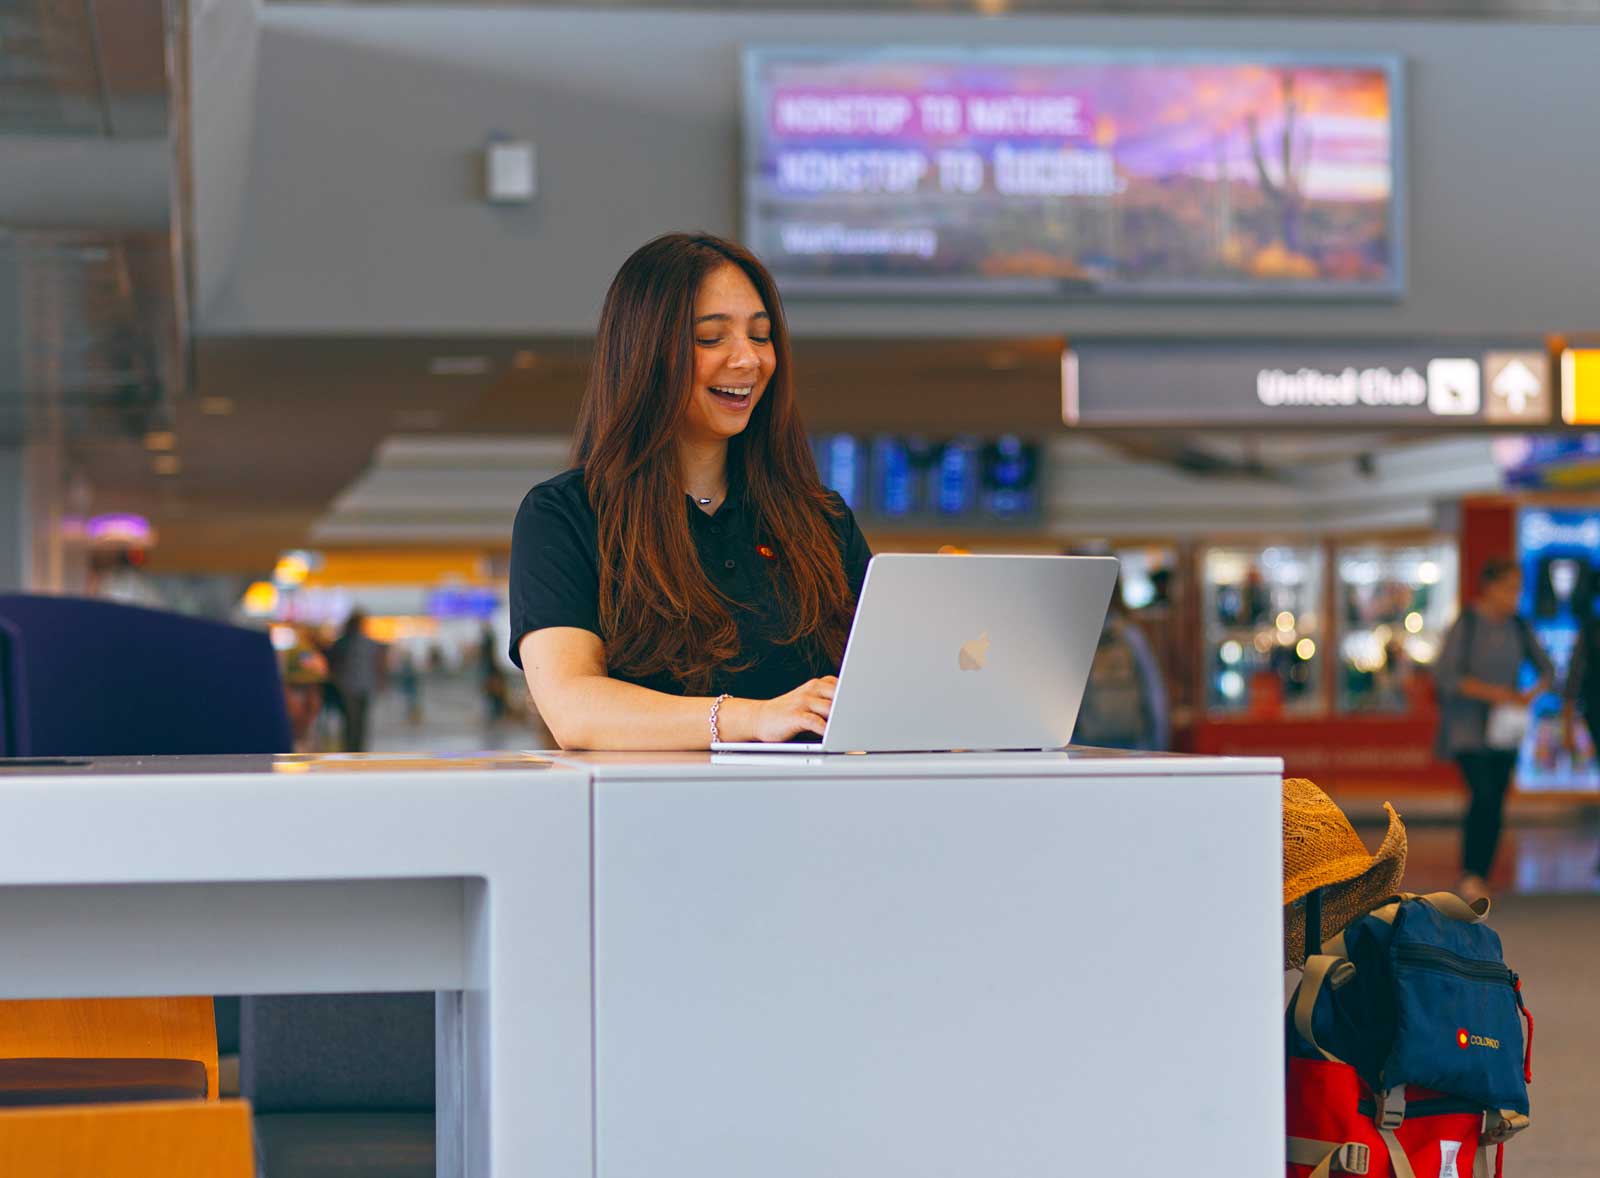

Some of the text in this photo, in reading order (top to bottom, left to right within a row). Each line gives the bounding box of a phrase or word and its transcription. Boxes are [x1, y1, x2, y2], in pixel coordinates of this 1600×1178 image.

[779, 95, 911, 134] NONSTOP
[921, 95, 963, 134] TO
[777, 151, 926, 193] NONSTOP
[939, 151, 984, 193] TO
[1257, 366, 1426, 406] United Club
